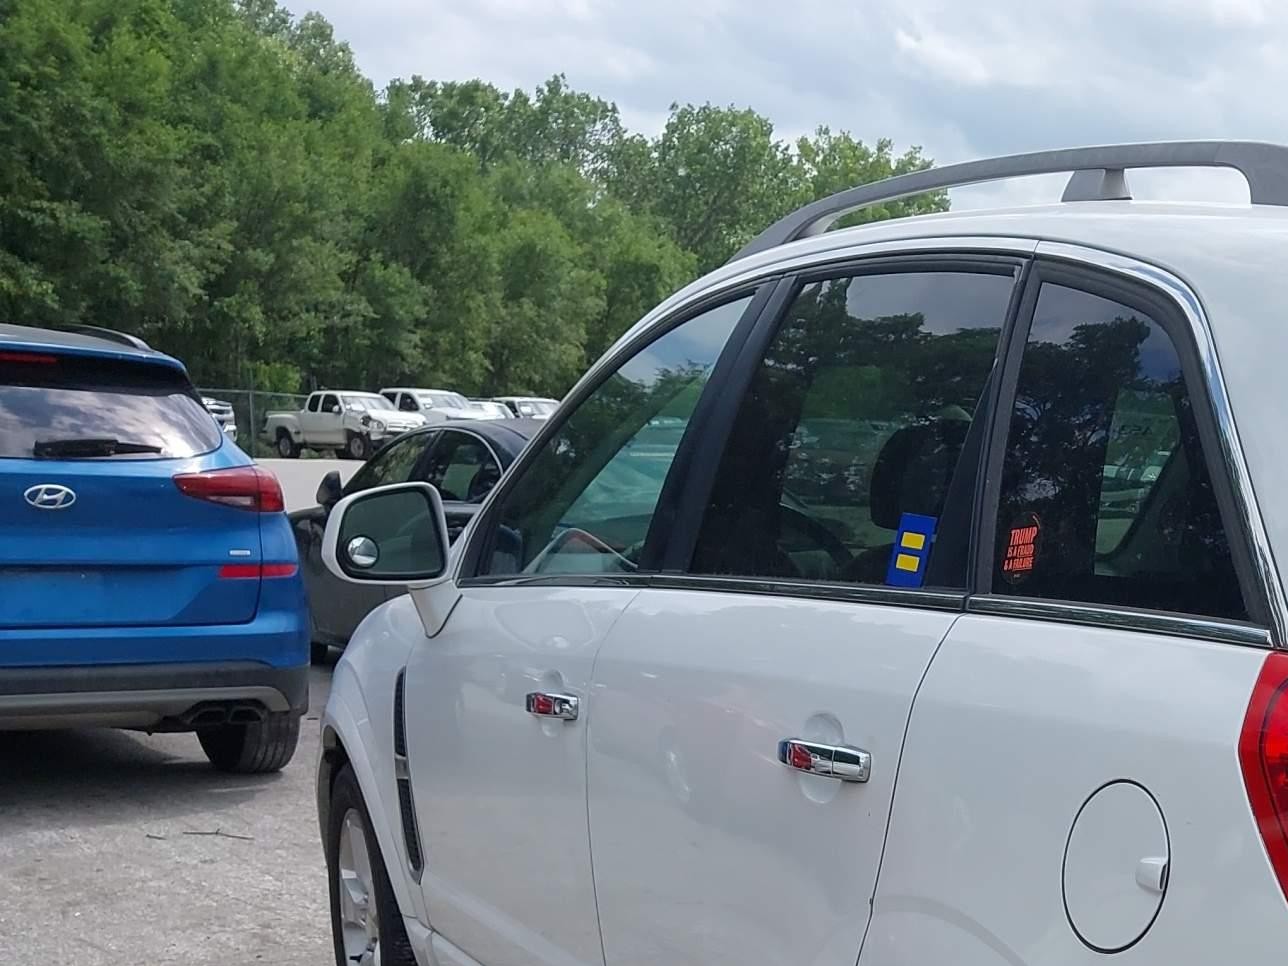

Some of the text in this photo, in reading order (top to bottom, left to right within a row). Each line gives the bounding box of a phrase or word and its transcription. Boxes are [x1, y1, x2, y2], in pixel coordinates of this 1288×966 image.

[1010, 527, 1038, 545] TRUMP
[1007, 544, 1034, 557] IS A FRAUD
[1008, 559, 1012, 570] A
